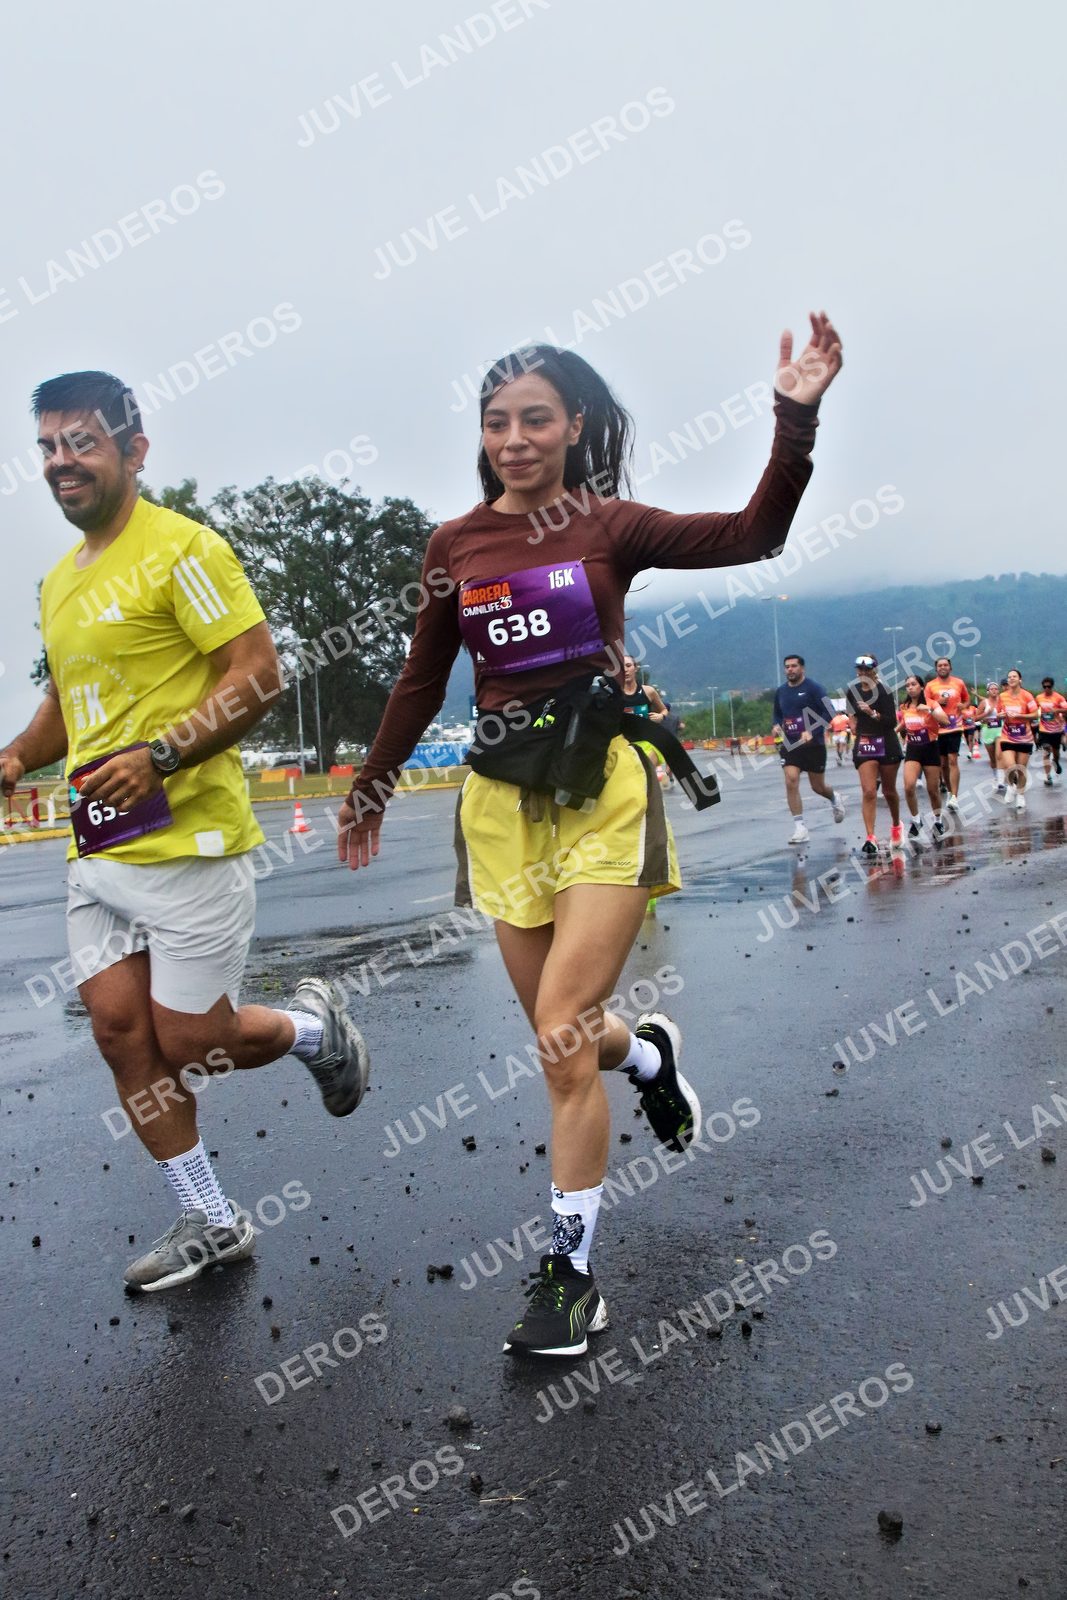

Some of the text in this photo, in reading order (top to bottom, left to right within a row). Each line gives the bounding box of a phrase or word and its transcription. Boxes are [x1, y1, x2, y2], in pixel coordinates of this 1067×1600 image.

[547, 567, 575, 590] 15K
[462, 582, 512, 606] CARRERA
[463, 602, 500, 617] OMNILIFE
[487, 608, 552, 646] 638
[87, 800, 130, 826] 63
